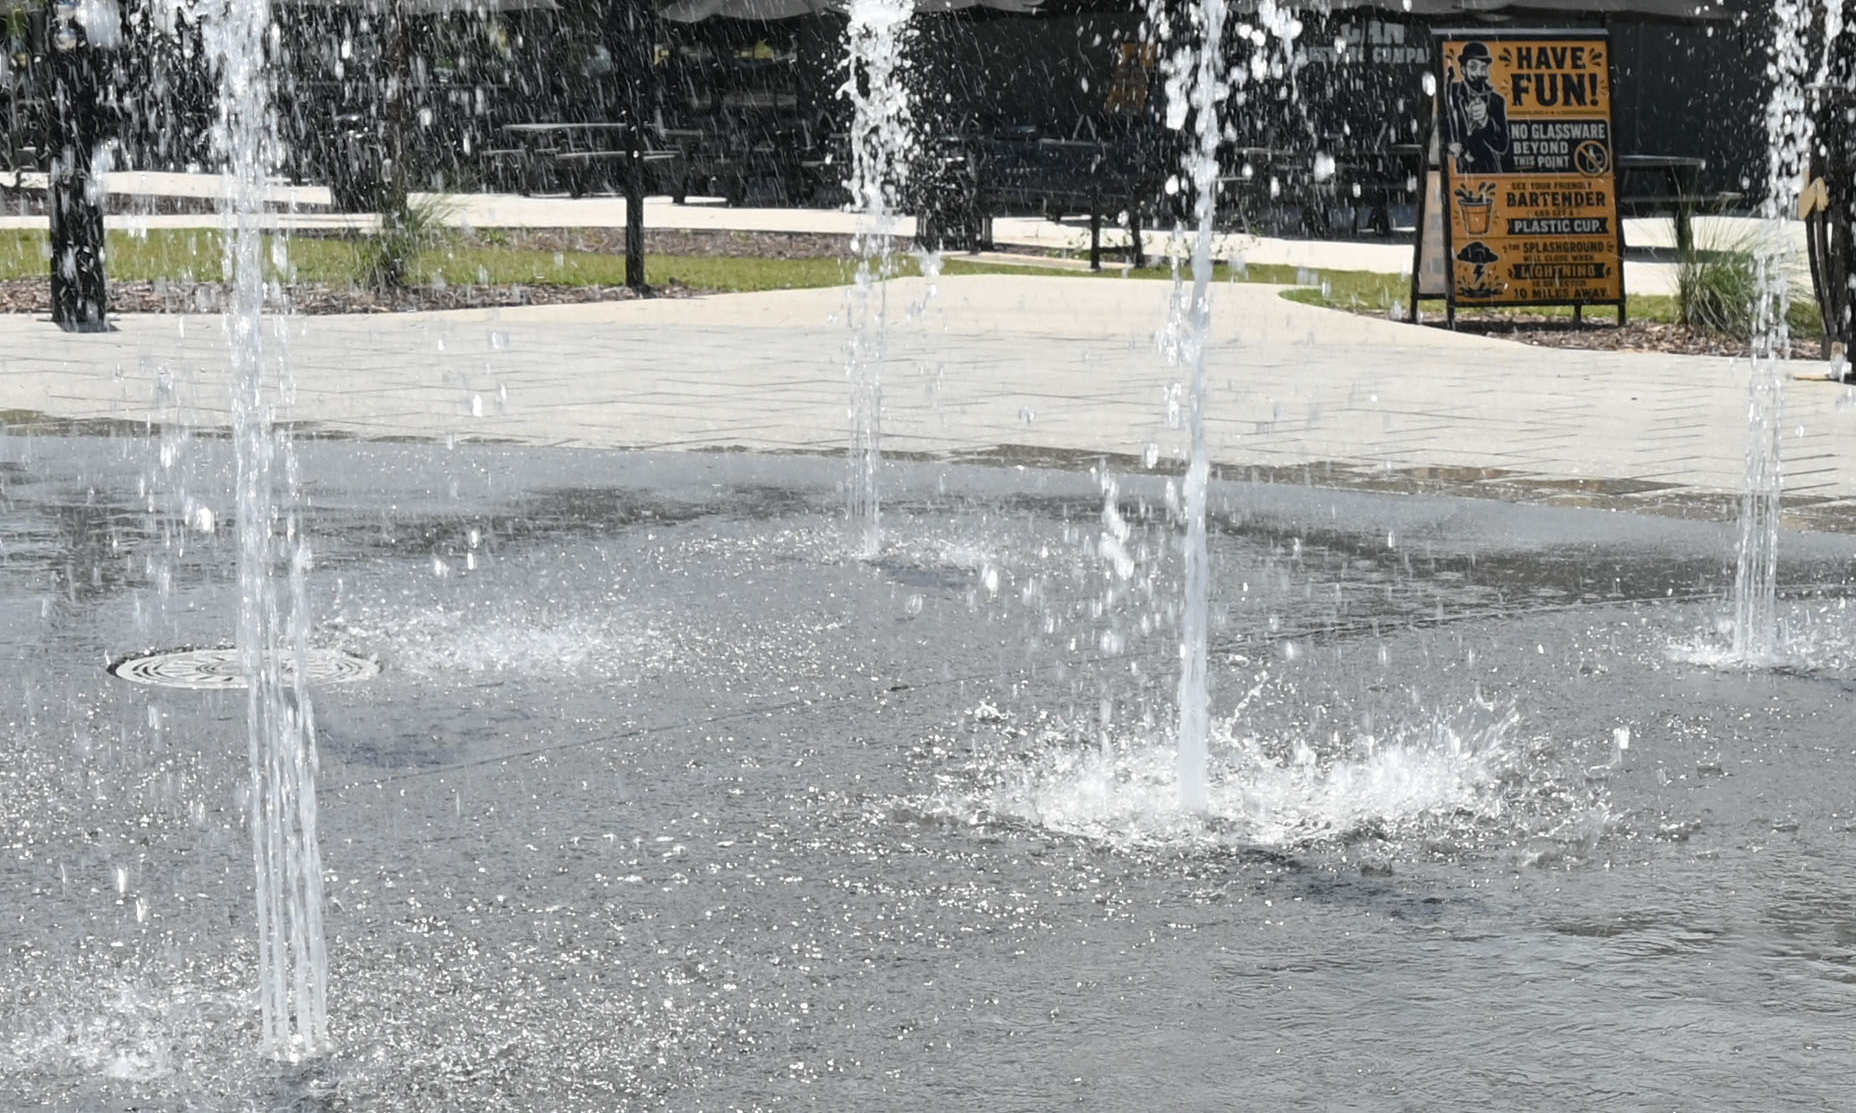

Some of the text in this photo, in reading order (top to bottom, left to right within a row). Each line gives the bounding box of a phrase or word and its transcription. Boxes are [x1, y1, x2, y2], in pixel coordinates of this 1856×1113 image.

[1516, 46, 1586, 70] HAVE
[1510, 73, 1599, 107] FUN!
[1511, 123, 1605, 139] NO GLASSWARE
[1513, 141, 1569, 154] BEYOND
[1513, 155, 1570, 168] THIS POINT
[1512, 181, 1592, 190] SEE YOUR FRIENDLY
[1506, 191, 1606, 207] BARTENDER
[1514, 219, 1602, 232] PLASTIC CUP.
[1523, 241, 1605, 253] SPLASHGROUND
[1544, 254, 1569, 262] CLOSE
[1521, 265, 1596, 278] LIGHTNING
[1514, 288, 1528, 299] 10
[1532, 288, 1570, 299] MILES
